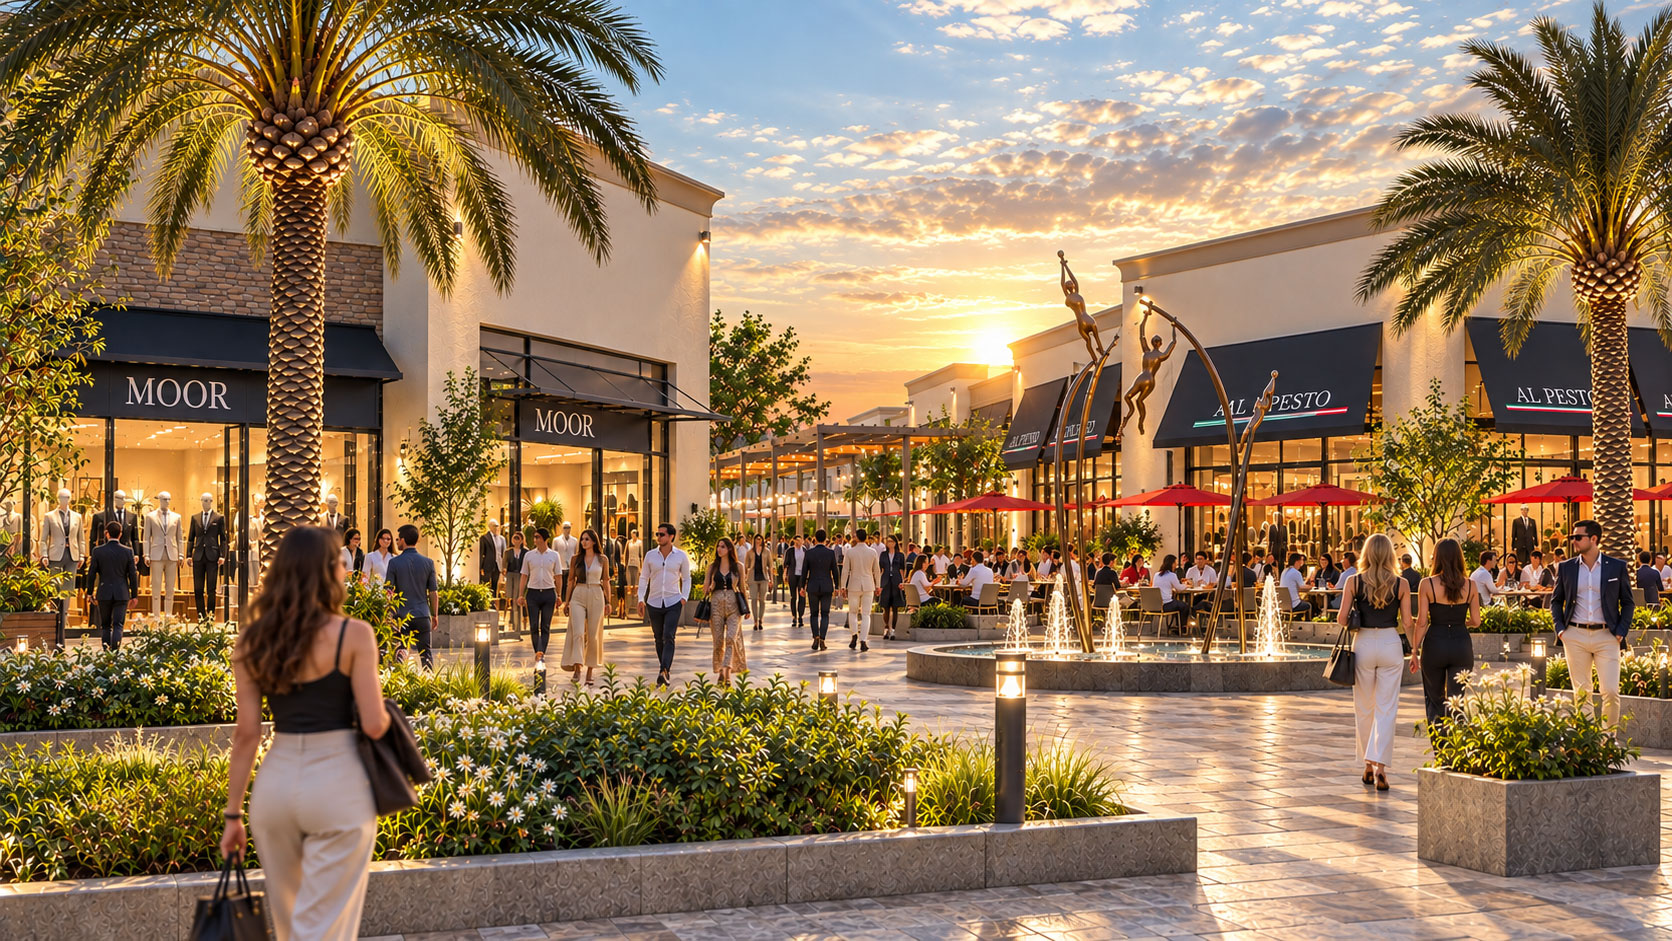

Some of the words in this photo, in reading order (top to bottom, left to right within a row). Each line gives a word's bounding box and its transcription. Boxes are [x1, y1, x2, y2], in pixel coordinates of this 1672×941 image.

[125, 376, 231, 410] MOOR
[1268, 389, 1331, 412] PESTO
[1517, 386, 1541, 404] AL
[534, 407, 595, 438] MOOR
